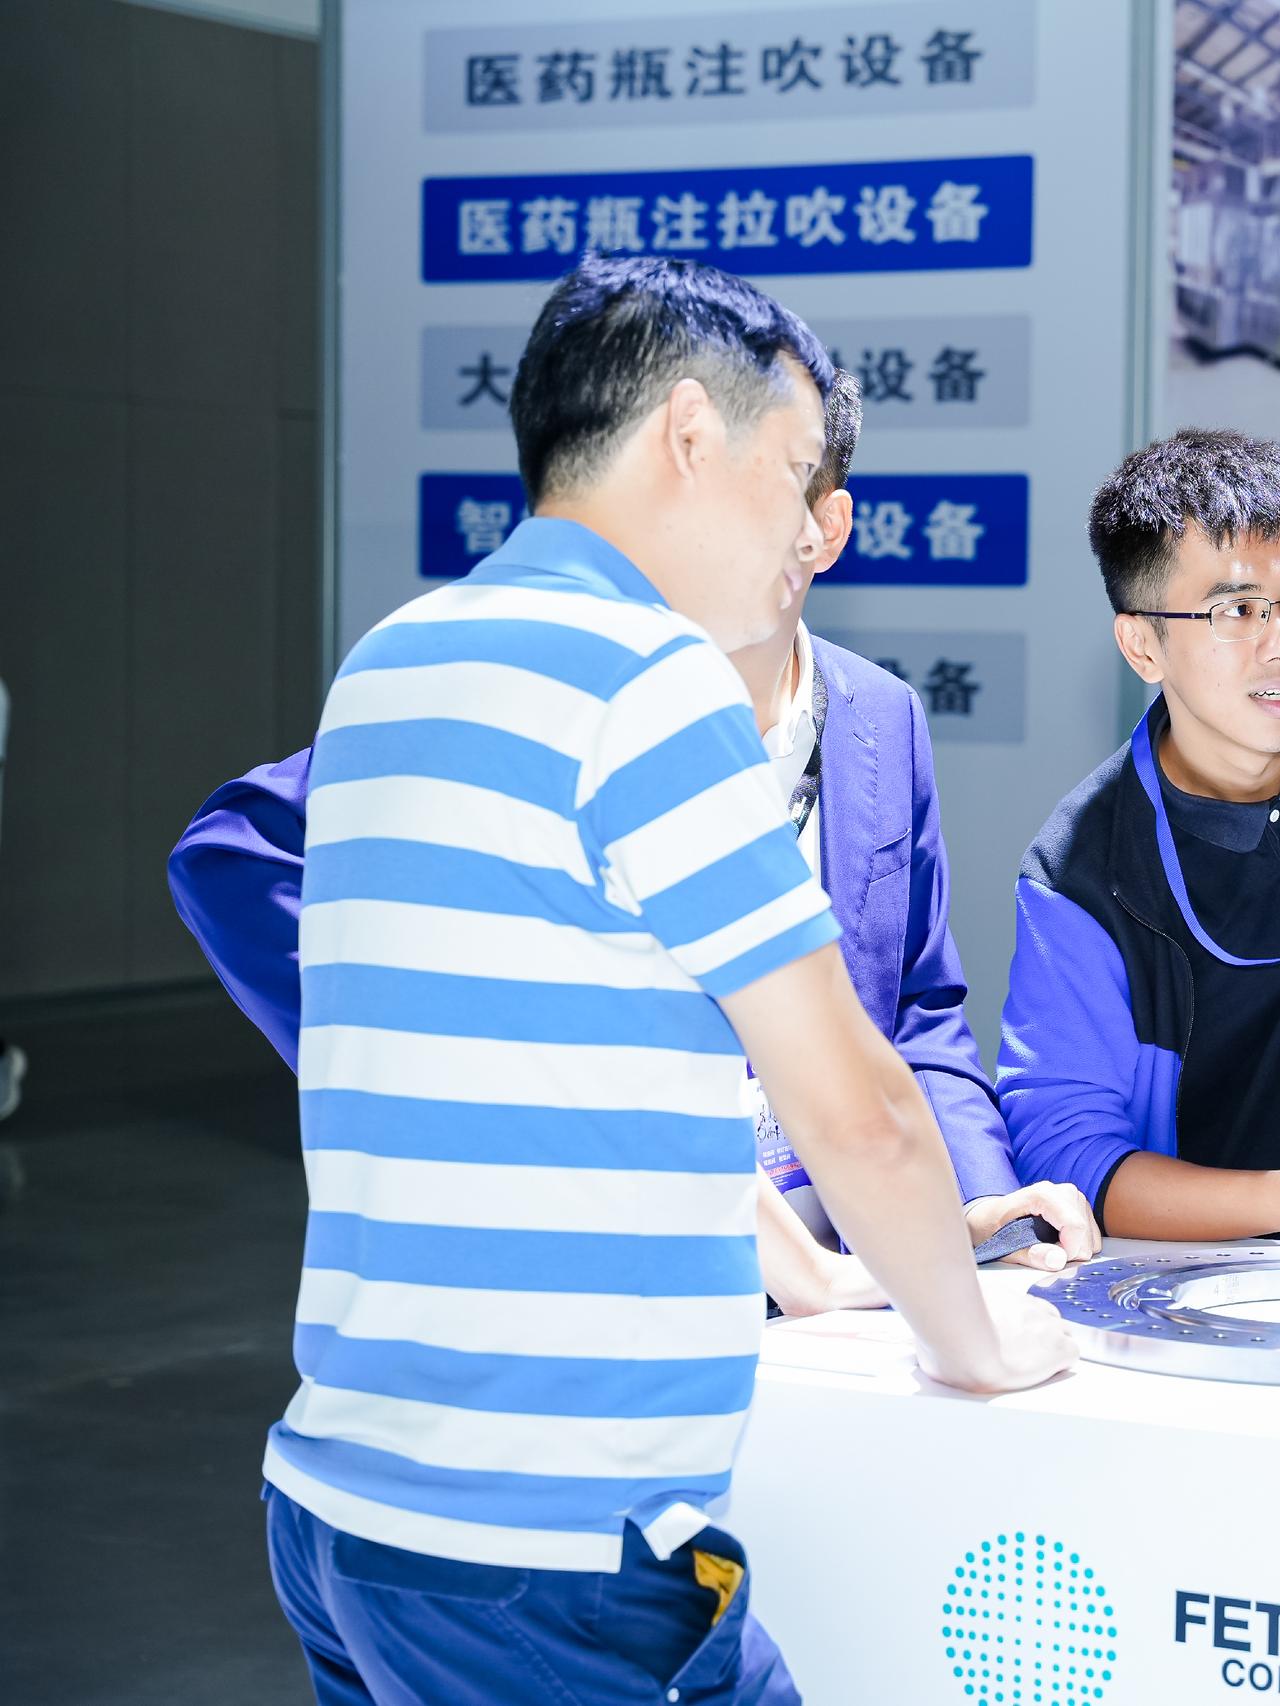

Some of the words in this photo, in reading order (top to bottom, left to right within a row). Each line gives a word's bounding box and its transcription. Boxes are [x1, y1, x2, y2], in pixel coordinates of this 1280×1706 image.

[465, 28, 985, 106] 医药瓶注吹设备
[457, 181, 990, 255] 医药瓶注拉吹设备
[831, 344, 985, 404] 设备
